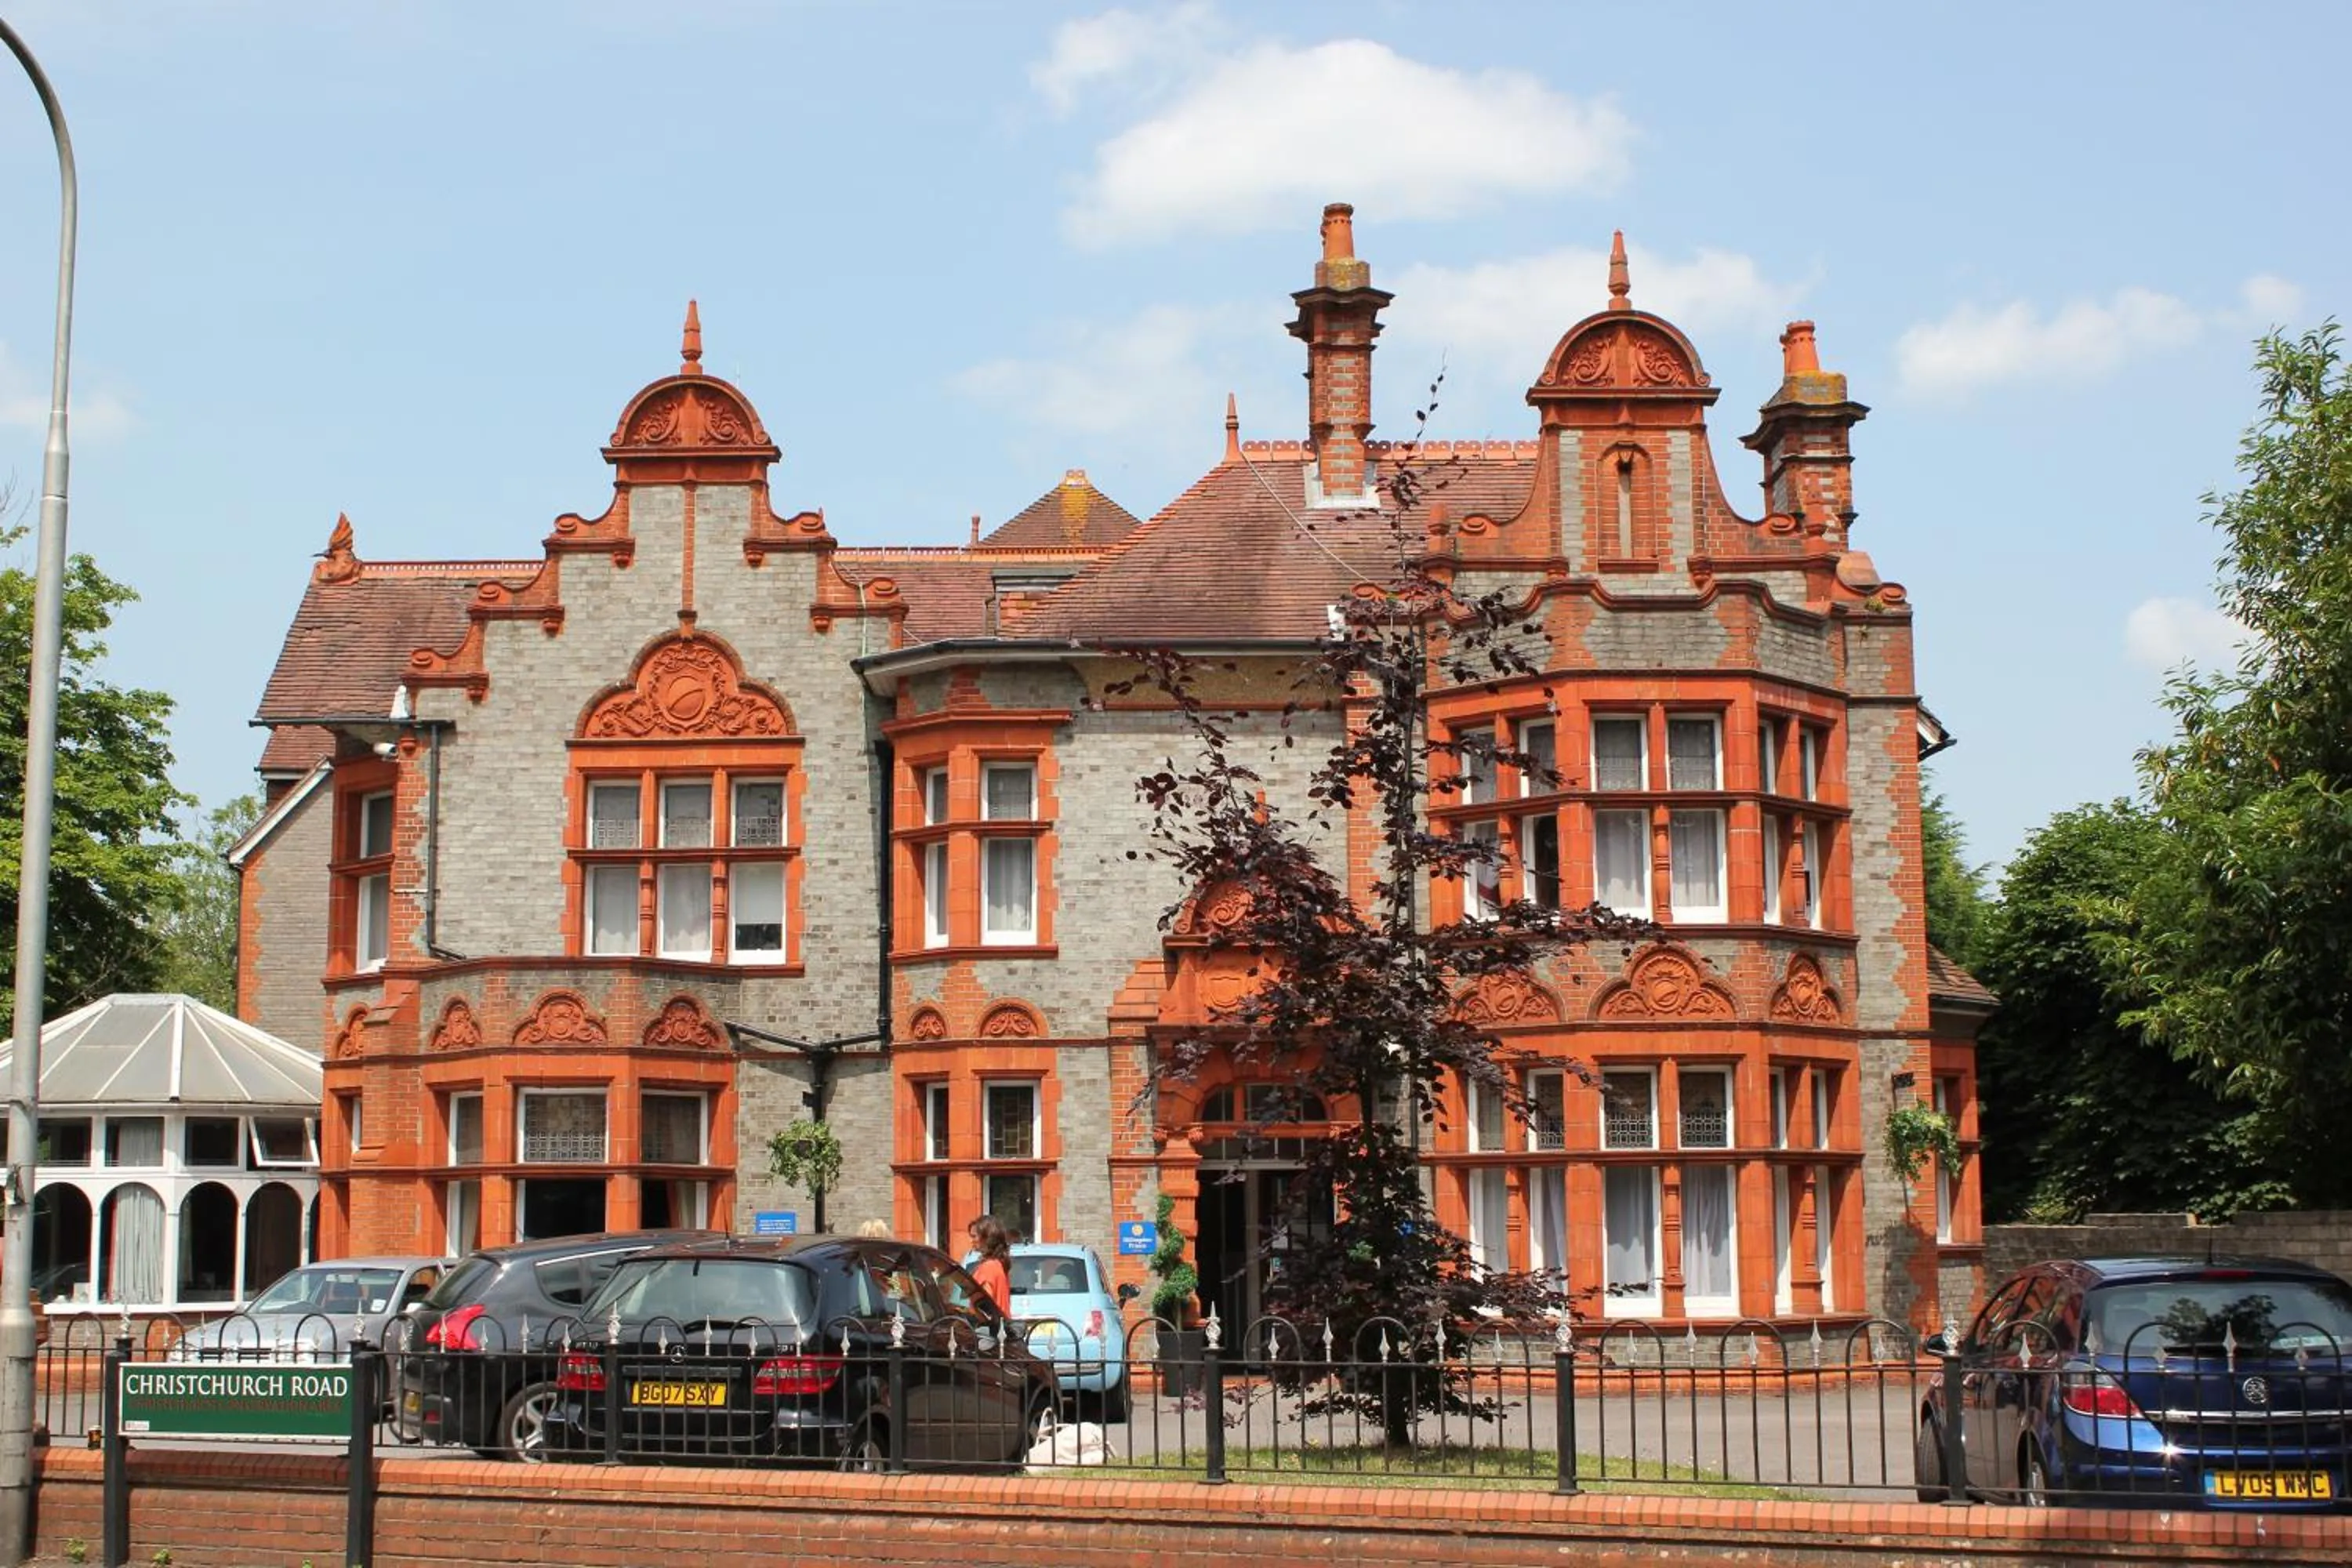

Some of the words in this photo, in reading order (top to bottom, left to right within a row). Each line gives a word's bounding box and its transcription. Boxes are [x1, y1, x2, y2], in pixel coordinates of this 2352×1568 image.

[125, 1374, 284, 1396] CHRISTCHURCH
[291, 1375, 348, 1397] ROAD
[2283, 1474, 2324, 1494] WMC
